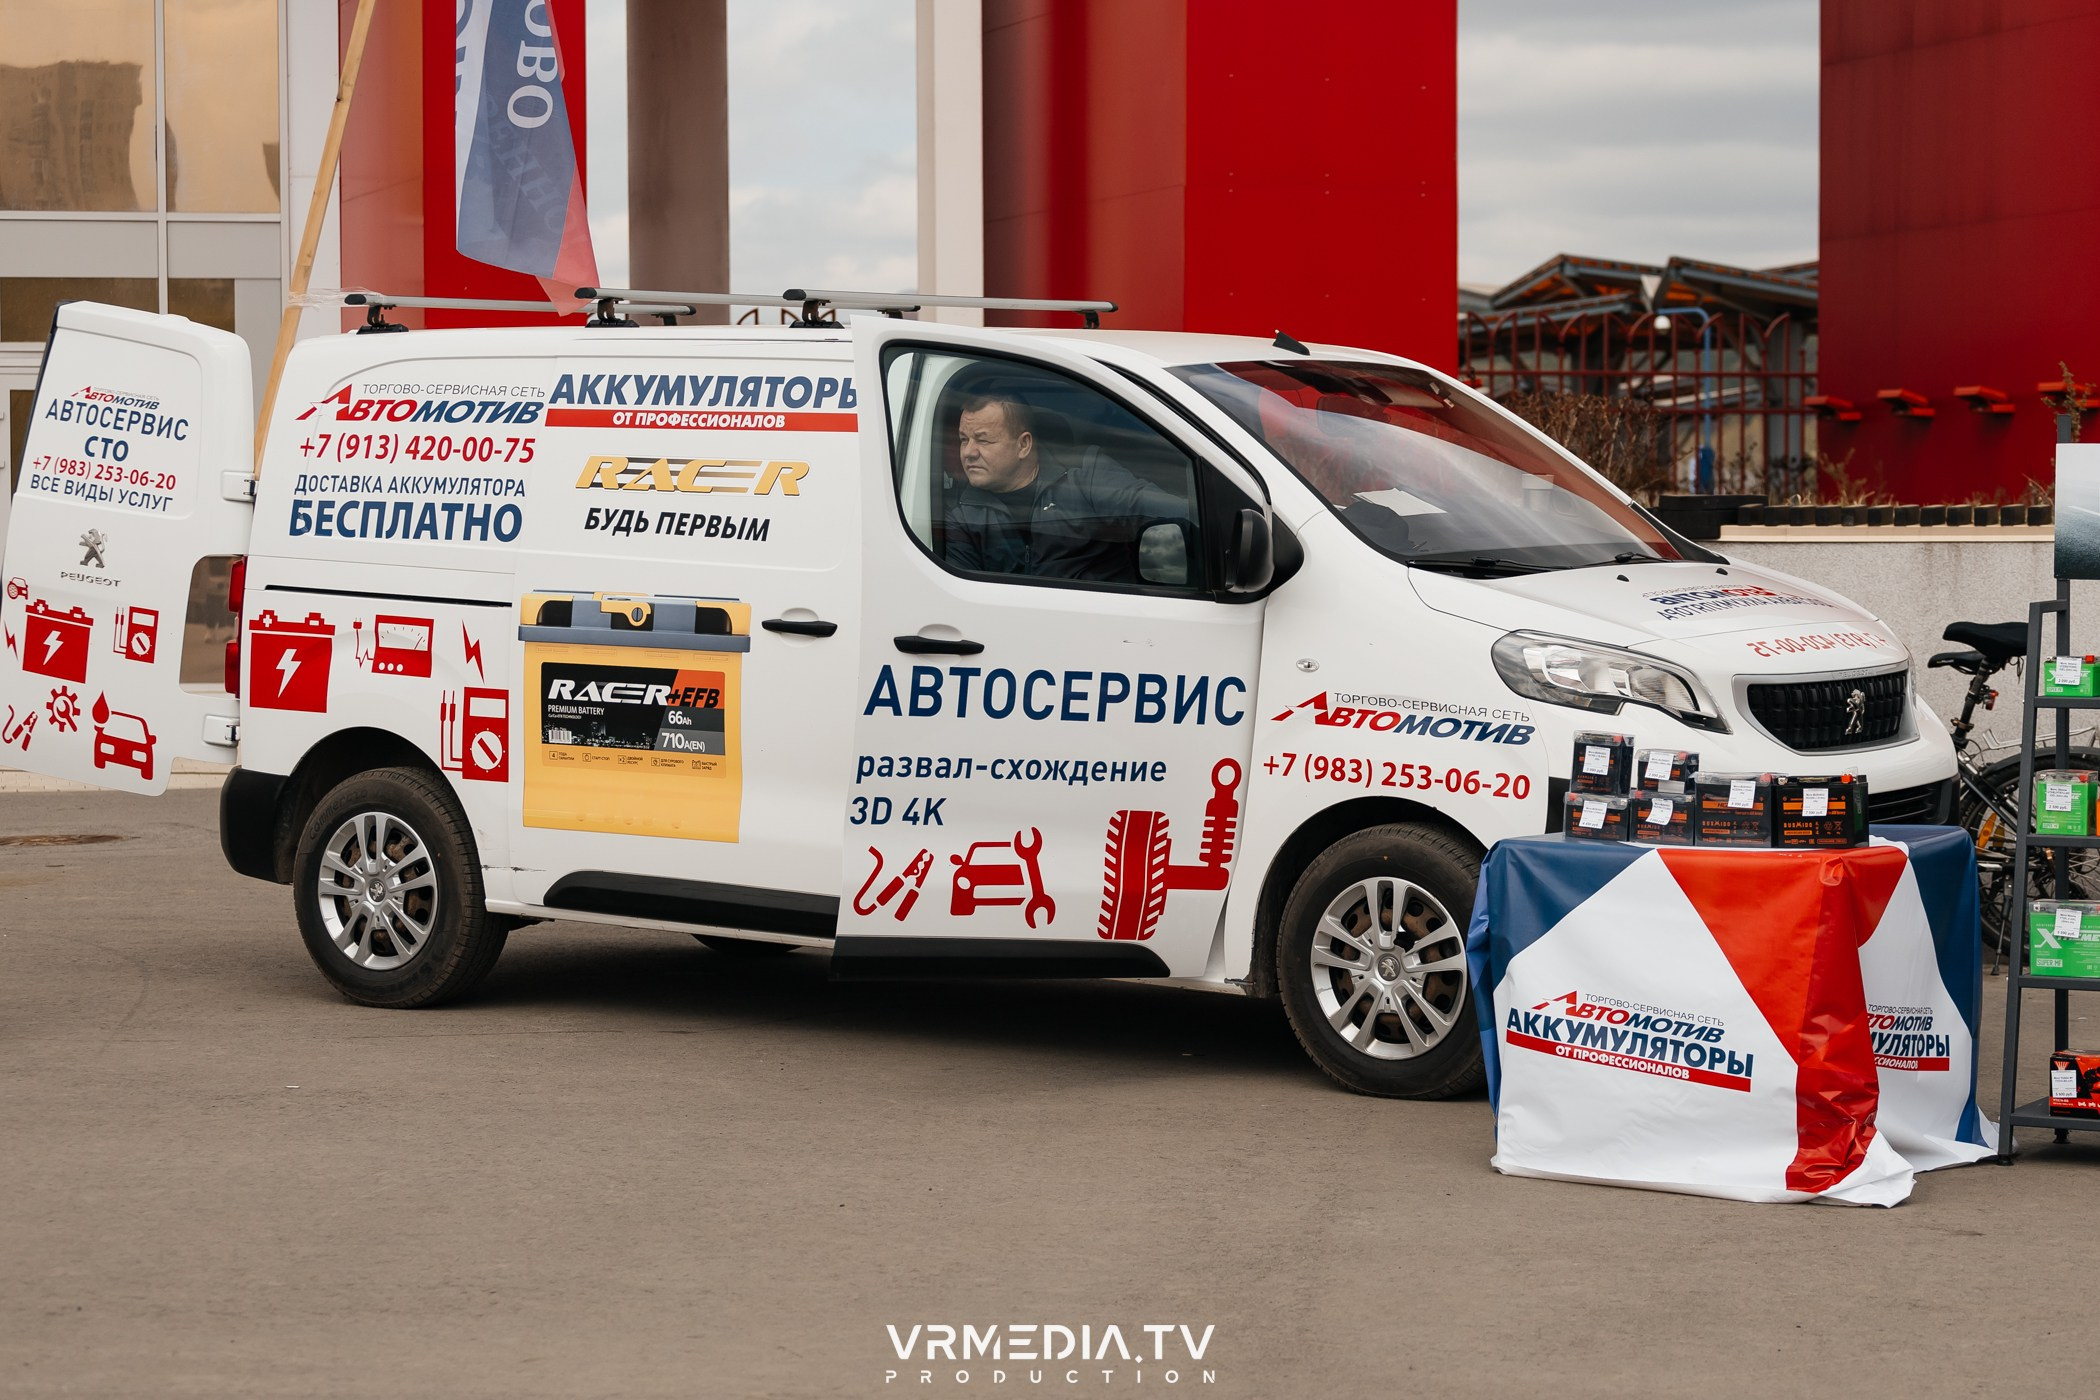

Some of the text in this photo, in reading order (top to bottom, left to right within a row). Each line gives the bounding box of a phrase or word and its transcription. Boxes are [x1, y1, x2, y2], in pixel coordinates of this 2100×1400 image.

[71, 386, 160, 409] АВТОМОТИВ
[295, 384, 545, 424] АВТОМОТИВ
[363, 383, 545, 398] ТОРГОВО-СЕРВИСНАЯ СЕТЬ
[45, 398, 189, 440] АВТОСЕРВИС
[612, 412, 786, 428] ОТ ПРОФЕССИОНАЛОВ
[84, 436, 129, 461] СТО
[300, 432, 536, 464] +7 (913) 420-00-75
[33, 456, 176, 490] +7 (983) 253-06-20
[294, 474, 526, 498] ДОСТАВКА АККУМУЛЯТОРА
[575, 456, 810, 496] RACER
[30, 474, 173, 512] ВСЕ ВИДЫ УСЛУГ
[289, 499, 523, 543] БЕСПЛАТНО
[584, 507, 770, 542] БУДЬ ПЕРВЫМ
[60, 571, 121, 587] PEUGEOT
[548, 679, 720, 709] RACER +EFB
[548, 704, 605, 715] PREMIUM BATTERY
[863, 664, 1247, 727] АВТОСЕРВИС
[1334, 692, 1530, 722] ТОРГОВО-СЕРВИСНАЯ СЕТЬ
[1271, 691, 1535, 746] АВТОМОТИВ
[661, 732, 706, 752] 710A(EN)
[856, 754, 1167, 786] развал-схождение
[1264, 753, 1532, 800] +7 (983) 253-06-20
[850, 796, 947, 826] 3D 4K
[1532, 991, 1726, 1043] АВТОМОТИВ
[1584, 993, 1726, 1027] ТОРГОВО-СЕРВИСНАЯ СЕТЬ
[1506, 1008, 1755, 1078] АККУМУЛЯТОРЫ
[1555, 1046, 1691, 1080] ОТ ПРОФЕССИОНАЛОВ
